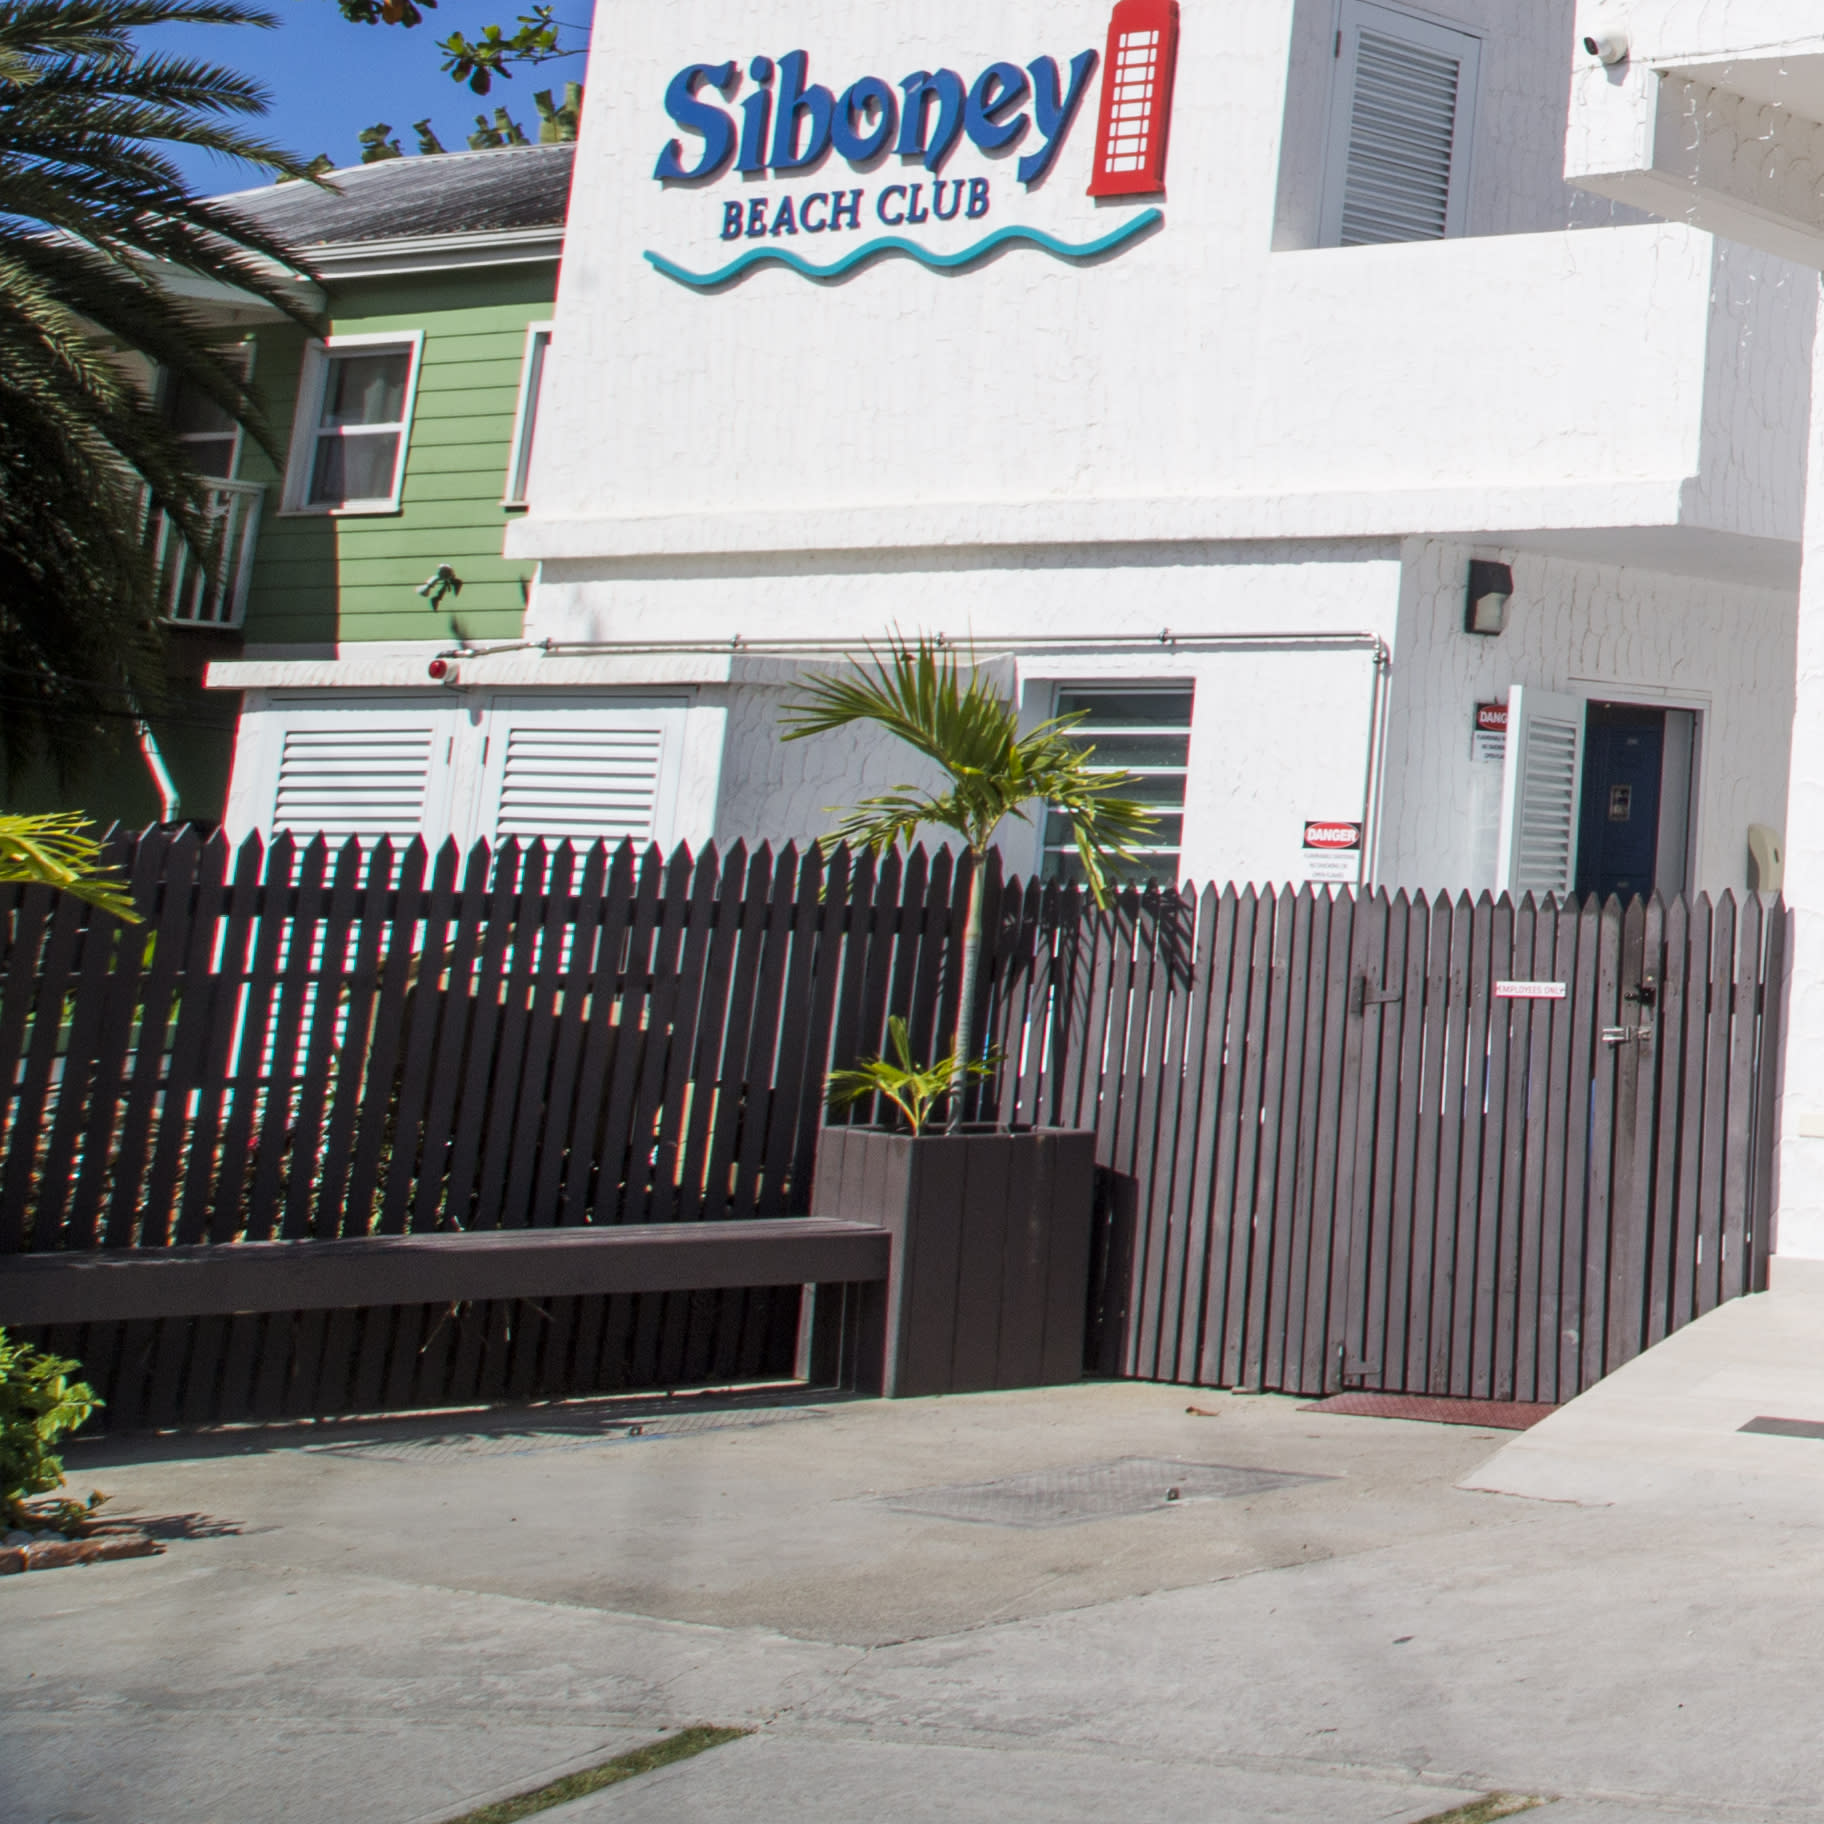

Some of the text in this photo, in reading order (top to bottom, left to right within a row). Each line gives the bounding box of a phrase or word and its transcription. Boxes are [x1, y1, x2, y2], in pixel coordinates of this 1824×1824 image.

[653, 48, 1100, 185] Siboney
[720, 176, 991, 241] BEACH CLUB
[1480, 711, 1508, 724] DANG
[1308, 828, 1358, 842] DANGER
[1500, 985, 1564, 994] EMPLOYEES ONLY
